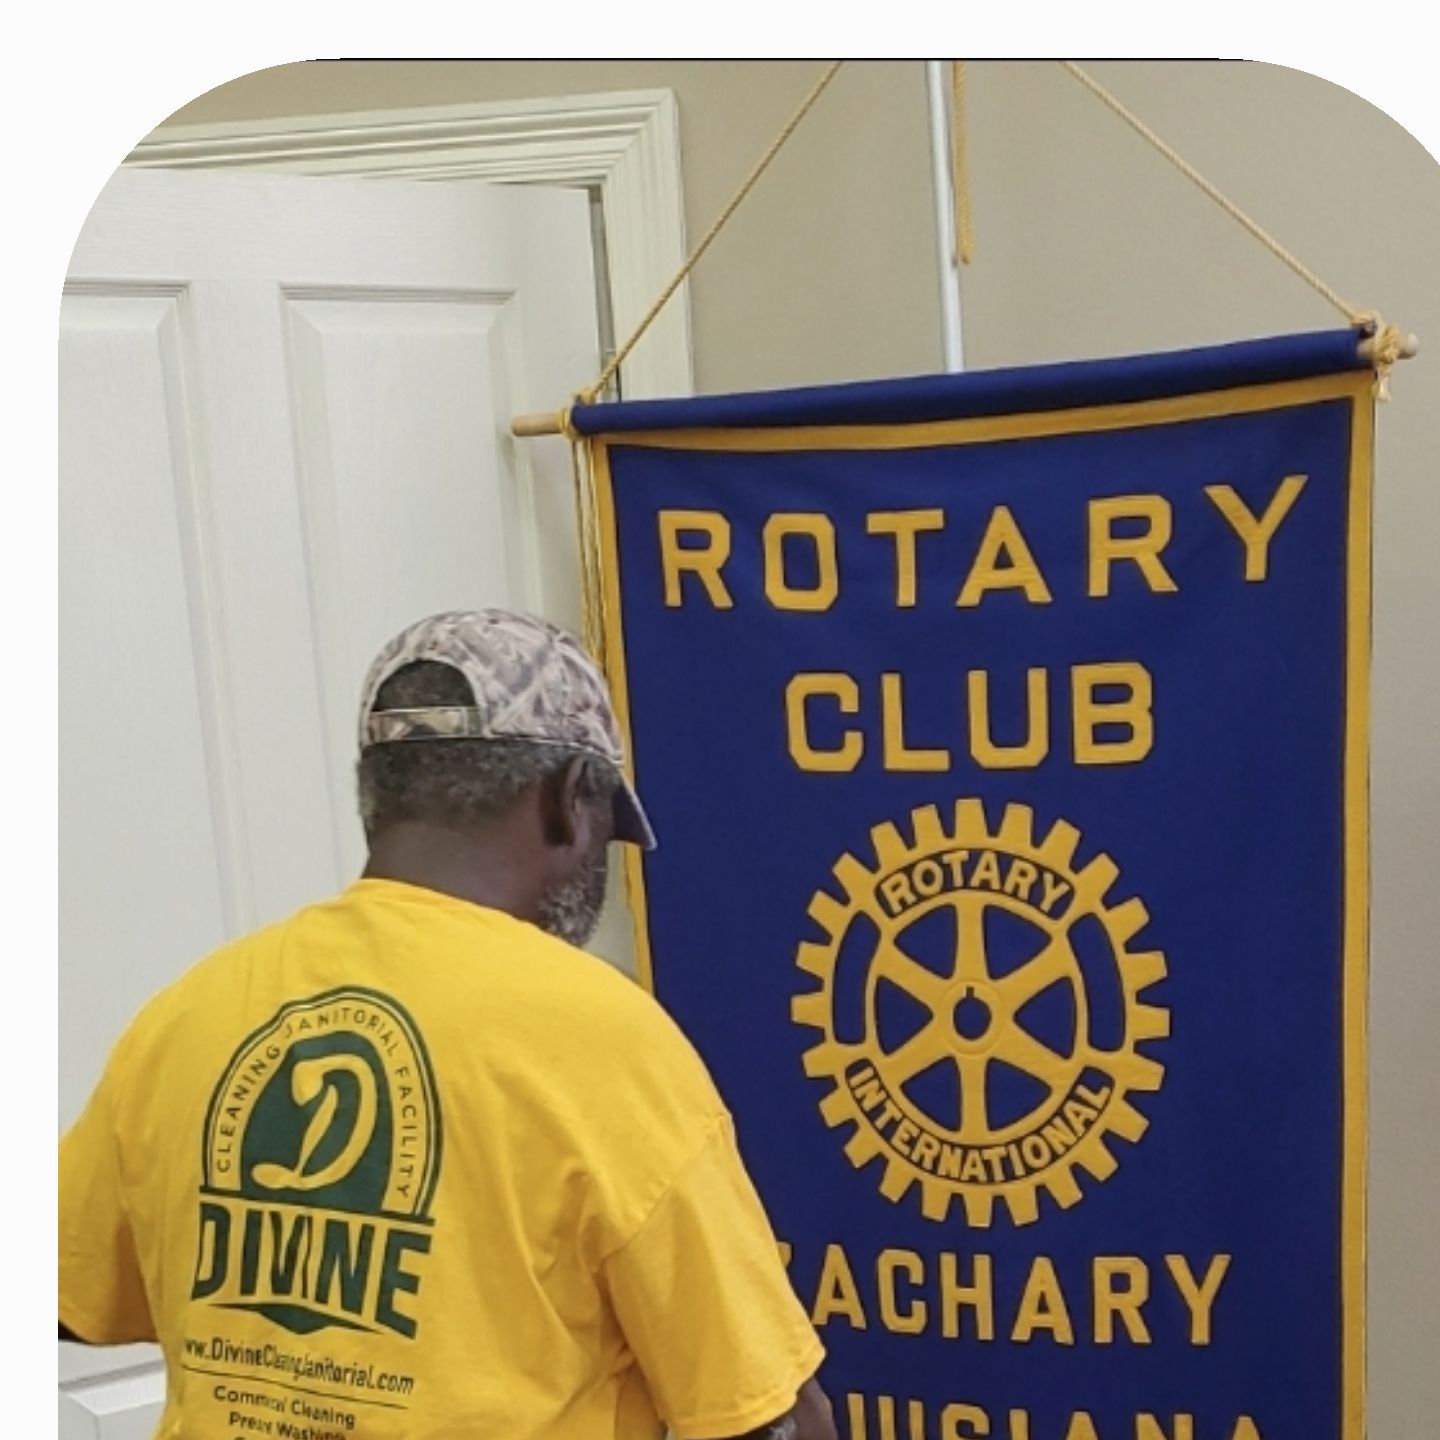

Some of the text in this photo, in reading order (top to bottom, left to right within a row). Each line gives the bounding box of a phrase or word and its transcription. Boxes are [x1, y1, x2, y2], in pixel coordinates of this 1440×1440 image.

[658, 474, 1309, 611] ROTARY
[785, 661, 1155, 772] CLUB
[880, 850, 1071, 914] ROTARY
[216, 1006, 418, 1199] CLEANING JANITORIAL FACILITY
[251, 1053, 379, 1192] D
[849, 1066, 1110, 1183] INTERNATIONAL
[779, 1241, 1232, 1346] ACHARY
[291, 1400, 355, 1430] Cleaning
